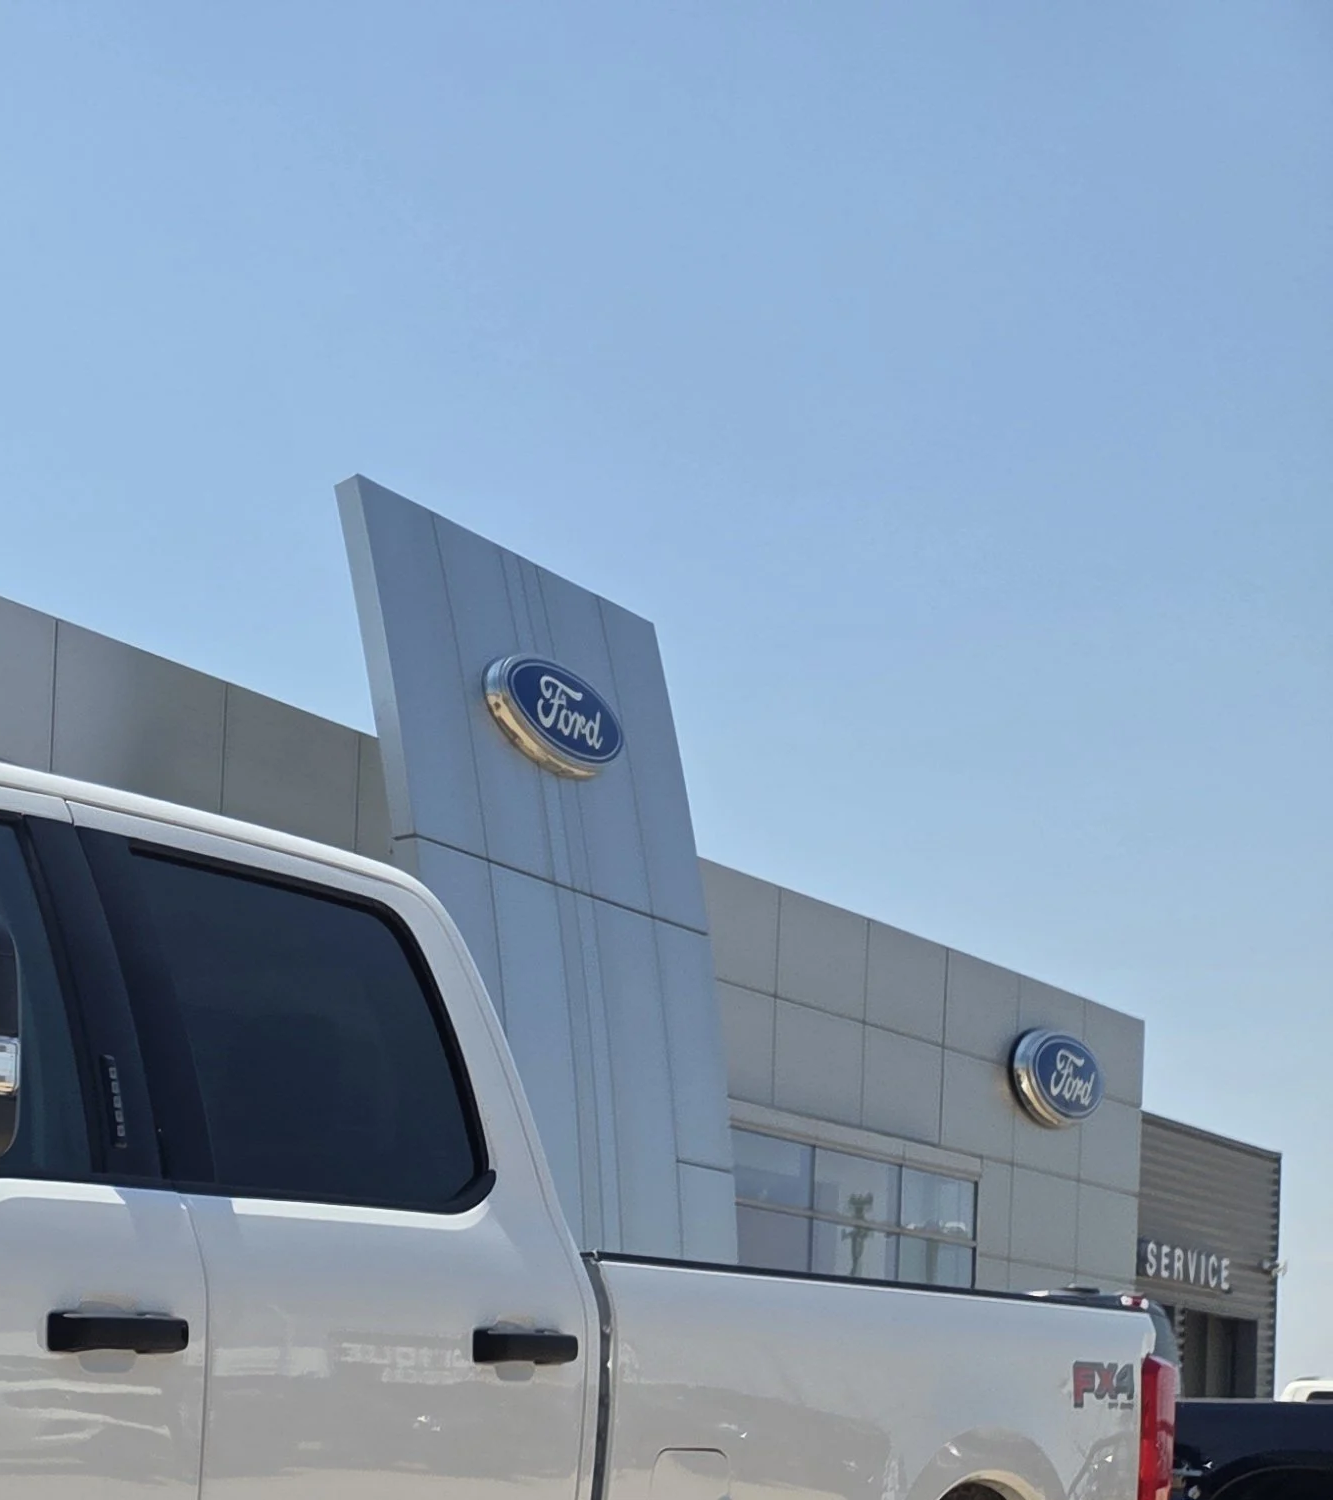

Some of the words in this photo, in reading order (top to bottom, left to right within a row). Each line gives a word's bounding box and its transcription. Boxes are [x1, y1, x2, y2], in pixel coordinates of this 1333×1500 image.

[537, 675, 604, 750] Ford
[1050, 1048, 1095, 1107] Ford
[1145, 1240, 1230, 1291] SERVICE
[1073, 1360, 1135, 1408] FX4
